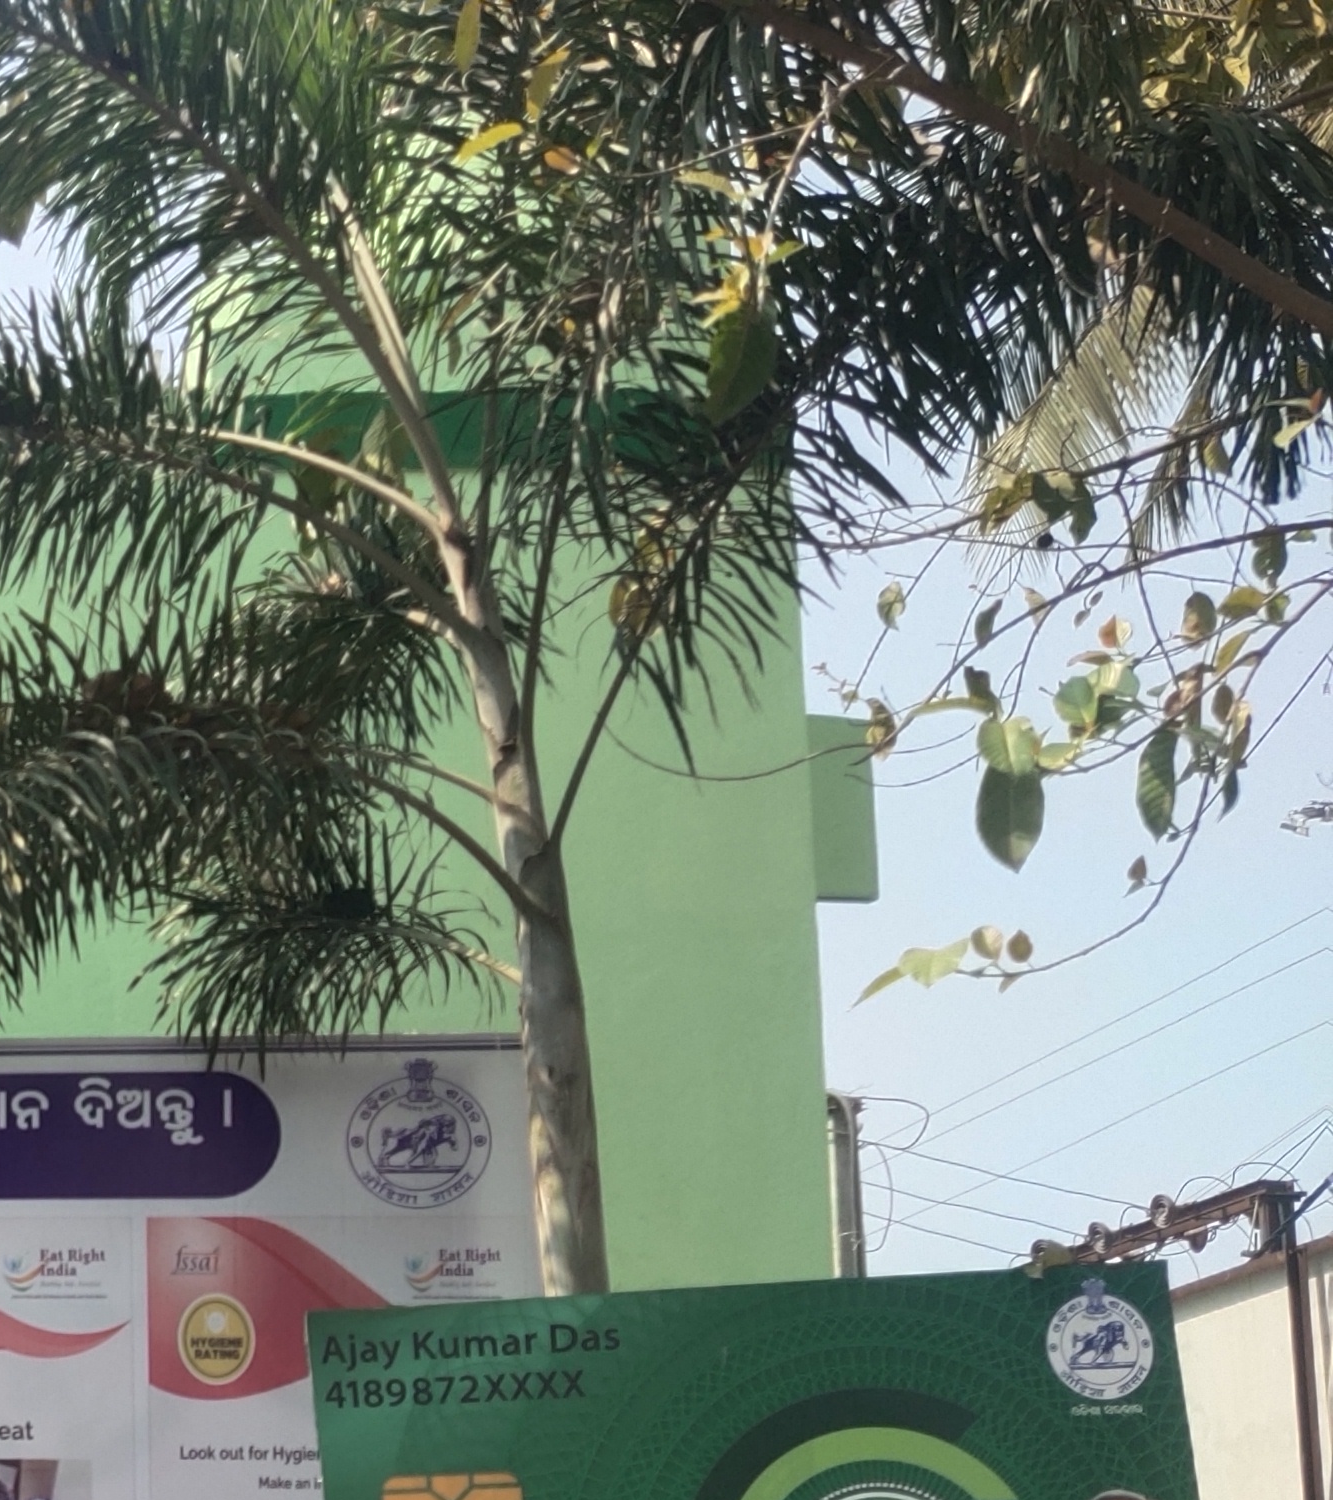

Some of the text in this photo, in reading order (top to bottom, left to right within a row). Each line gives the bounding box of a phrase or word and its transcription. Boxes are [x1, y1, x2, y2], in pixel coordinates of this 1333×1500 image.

[322, 1323, 620, 1372] Ajay Kumar Das
[180, 1446, 269, 1460] Look out for
[258, 1477, 310, 1490] Make an
